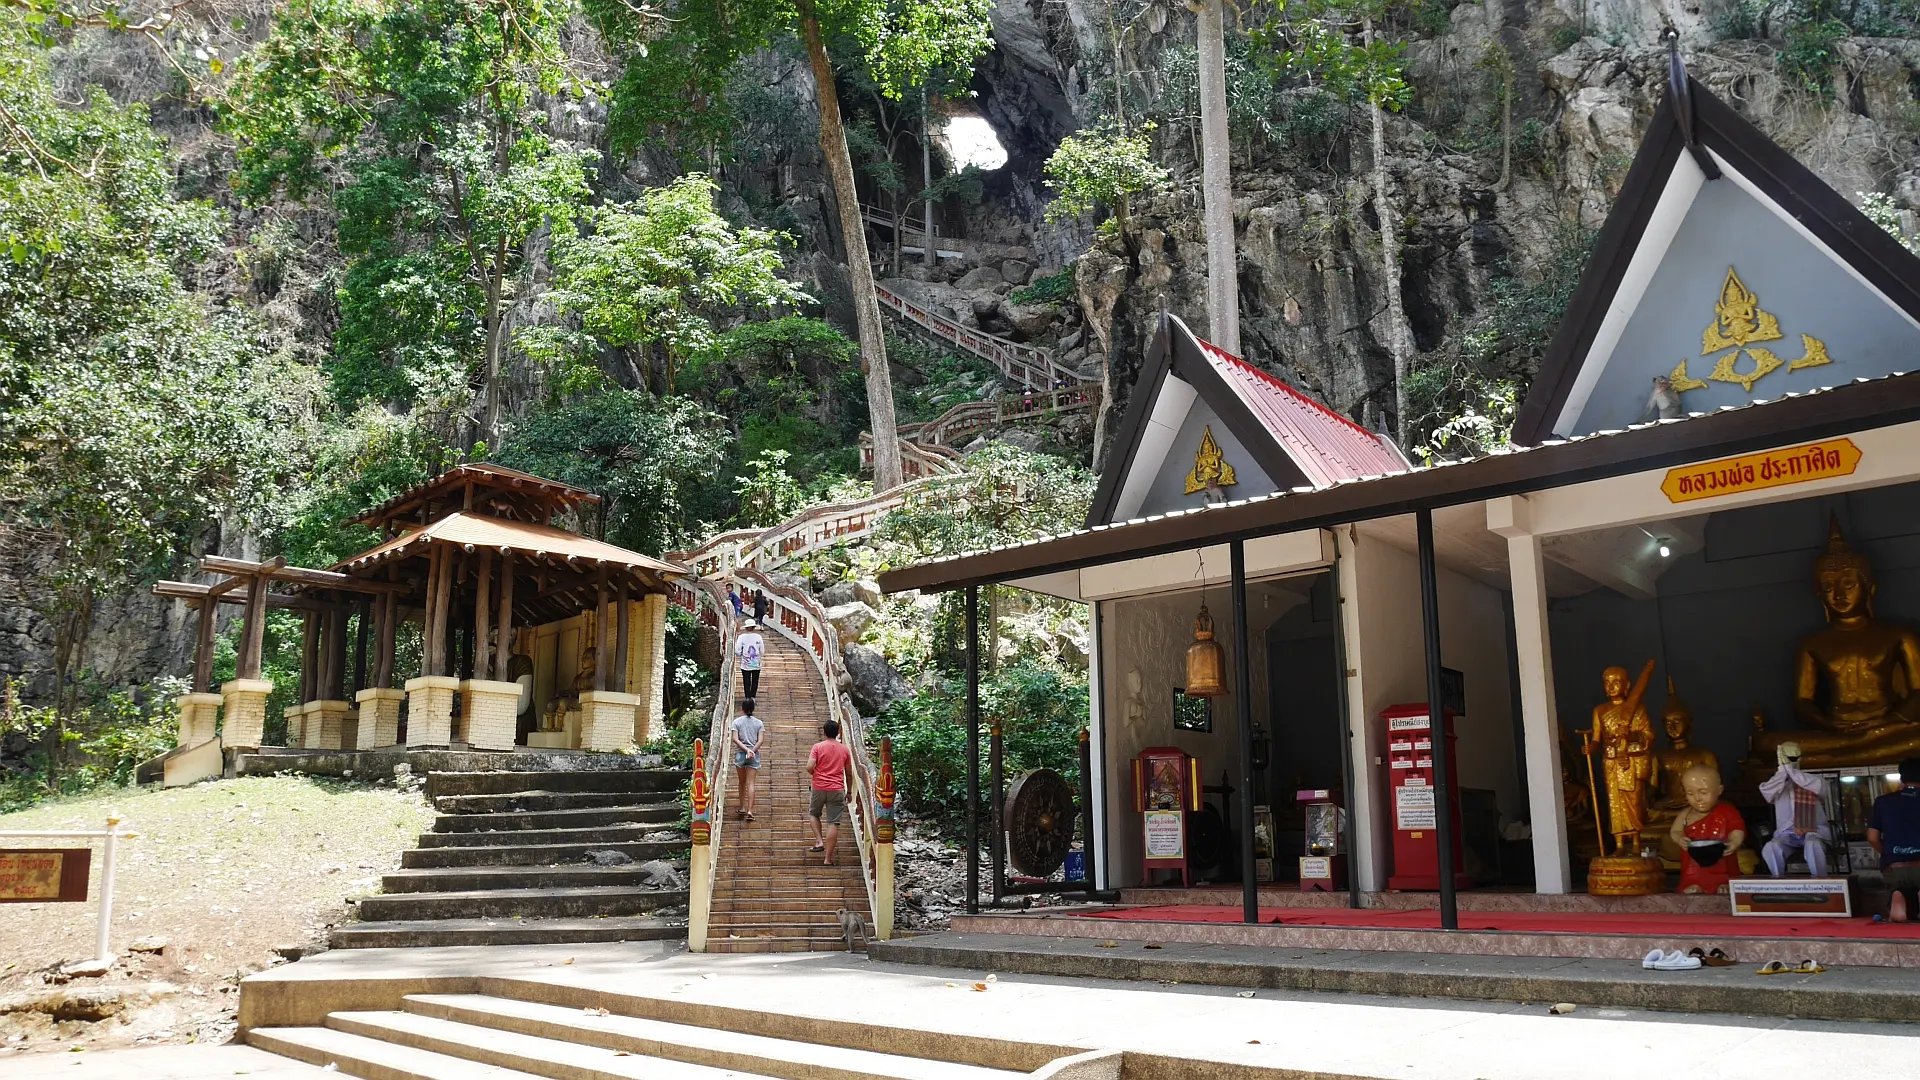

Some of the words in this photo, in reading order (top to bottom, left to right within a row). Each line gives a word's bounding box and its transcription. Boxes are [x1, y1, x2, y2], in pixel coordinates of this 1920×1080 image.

[1678, 463, 1755, 494] หลวงพ่อ
[1760, 446, 1841, 481] ประกาศิต
